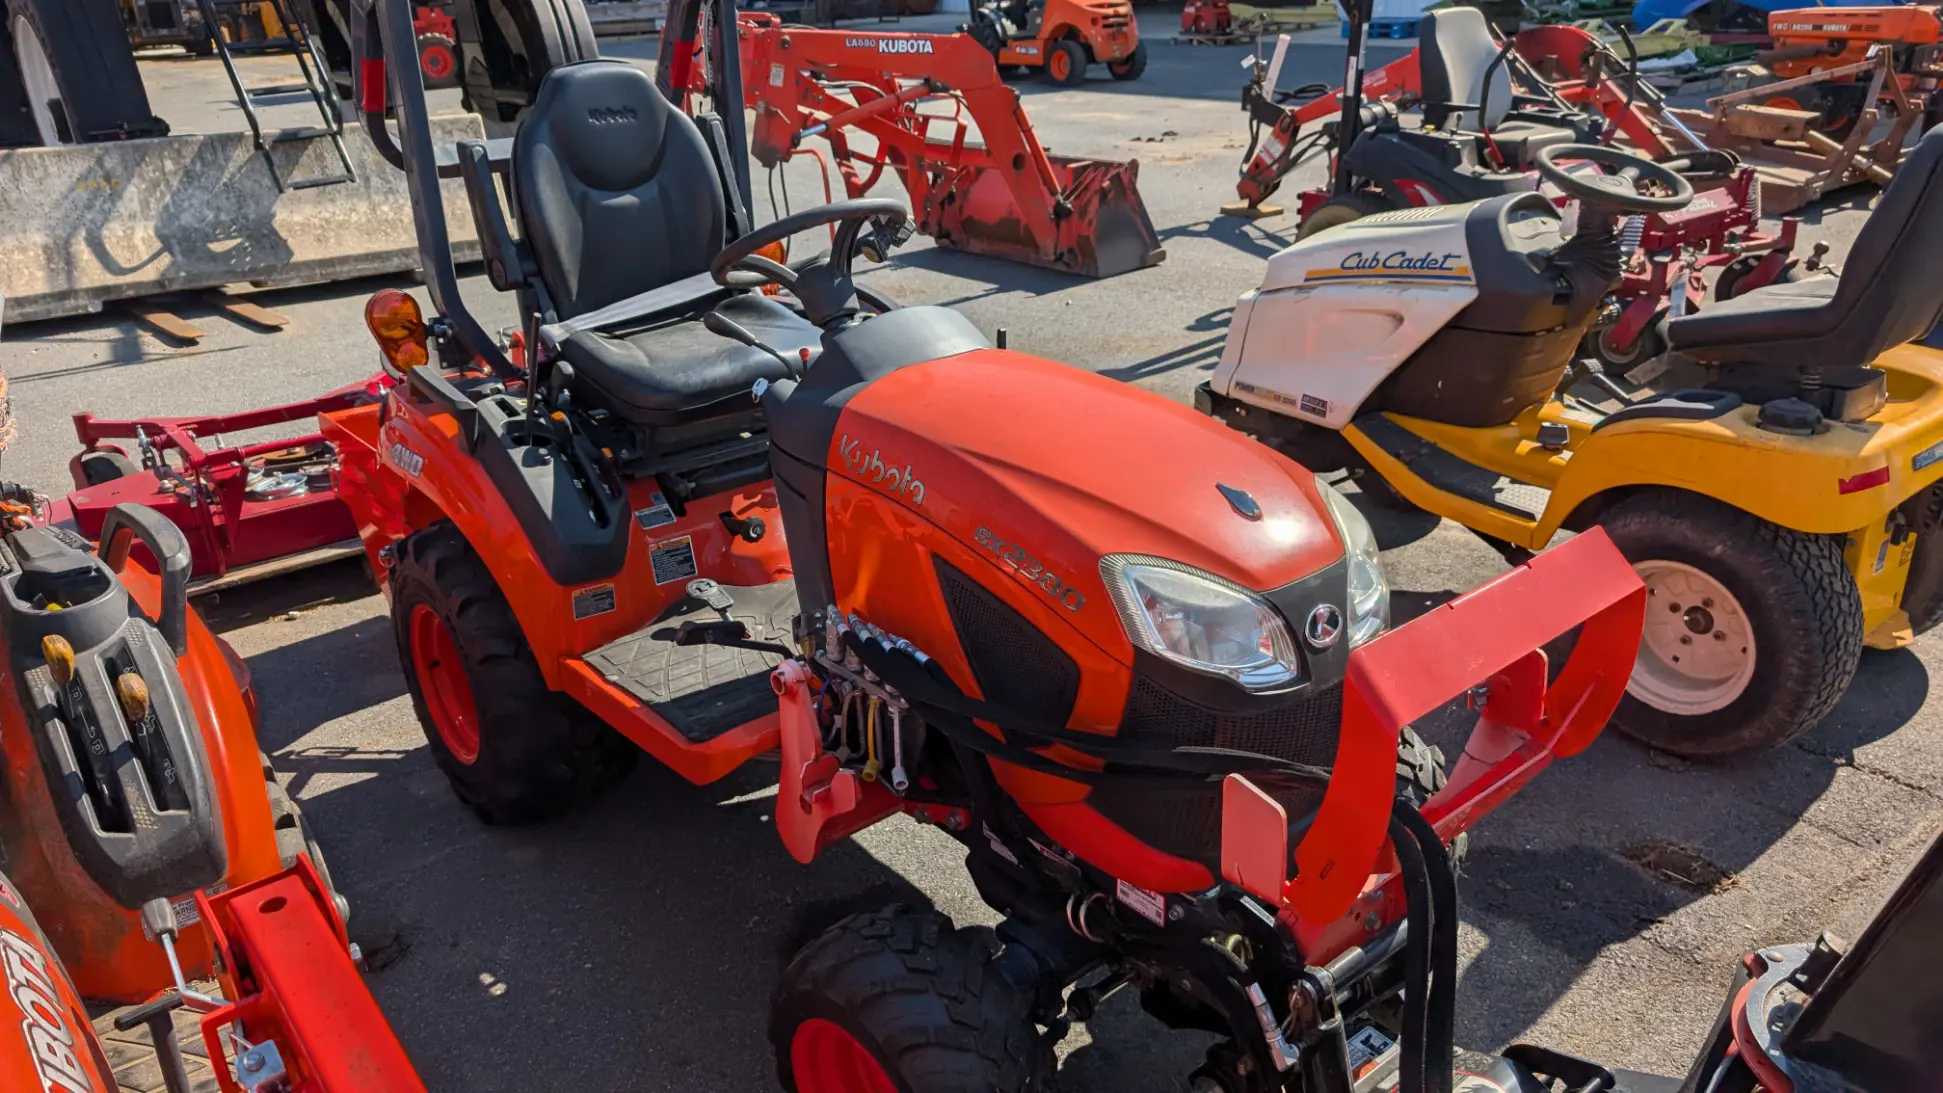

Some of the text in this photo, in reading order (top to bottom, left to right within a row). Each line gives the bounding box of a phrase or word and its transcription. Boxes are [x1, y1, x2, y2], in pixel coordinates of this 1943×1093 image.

[878, 39, 934, 54] KUBOTA
[1340, 251, 1462, 271] Cub Cadet
[391, 441, 425, 478] 4WD
[838, 433, 926, 506] Kubota
[973, 525, 1087, 614] BX2380
